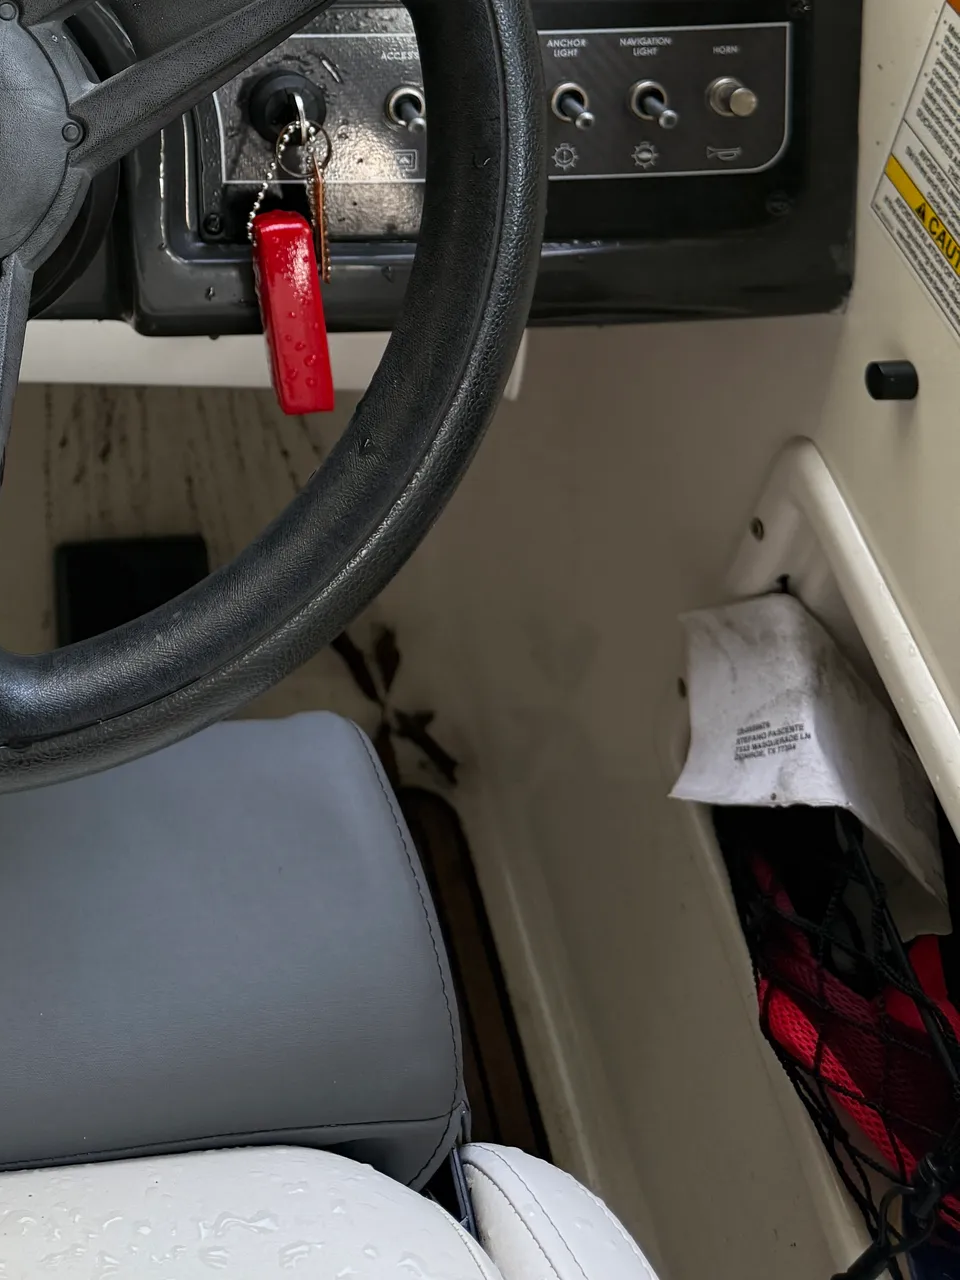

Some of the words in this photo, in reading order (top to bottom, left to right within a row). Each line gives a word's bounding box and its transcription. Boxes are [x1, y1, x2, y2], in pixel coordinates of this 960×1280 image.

[547, 39, 586, 47] ANCHOR
[619, 36, 672, 46] NAVIGATION
[554, 48, 578, 57] LIGHT
[633, 47, 658, 56] LIGHT
[713, 46, 738, 54] HORN
